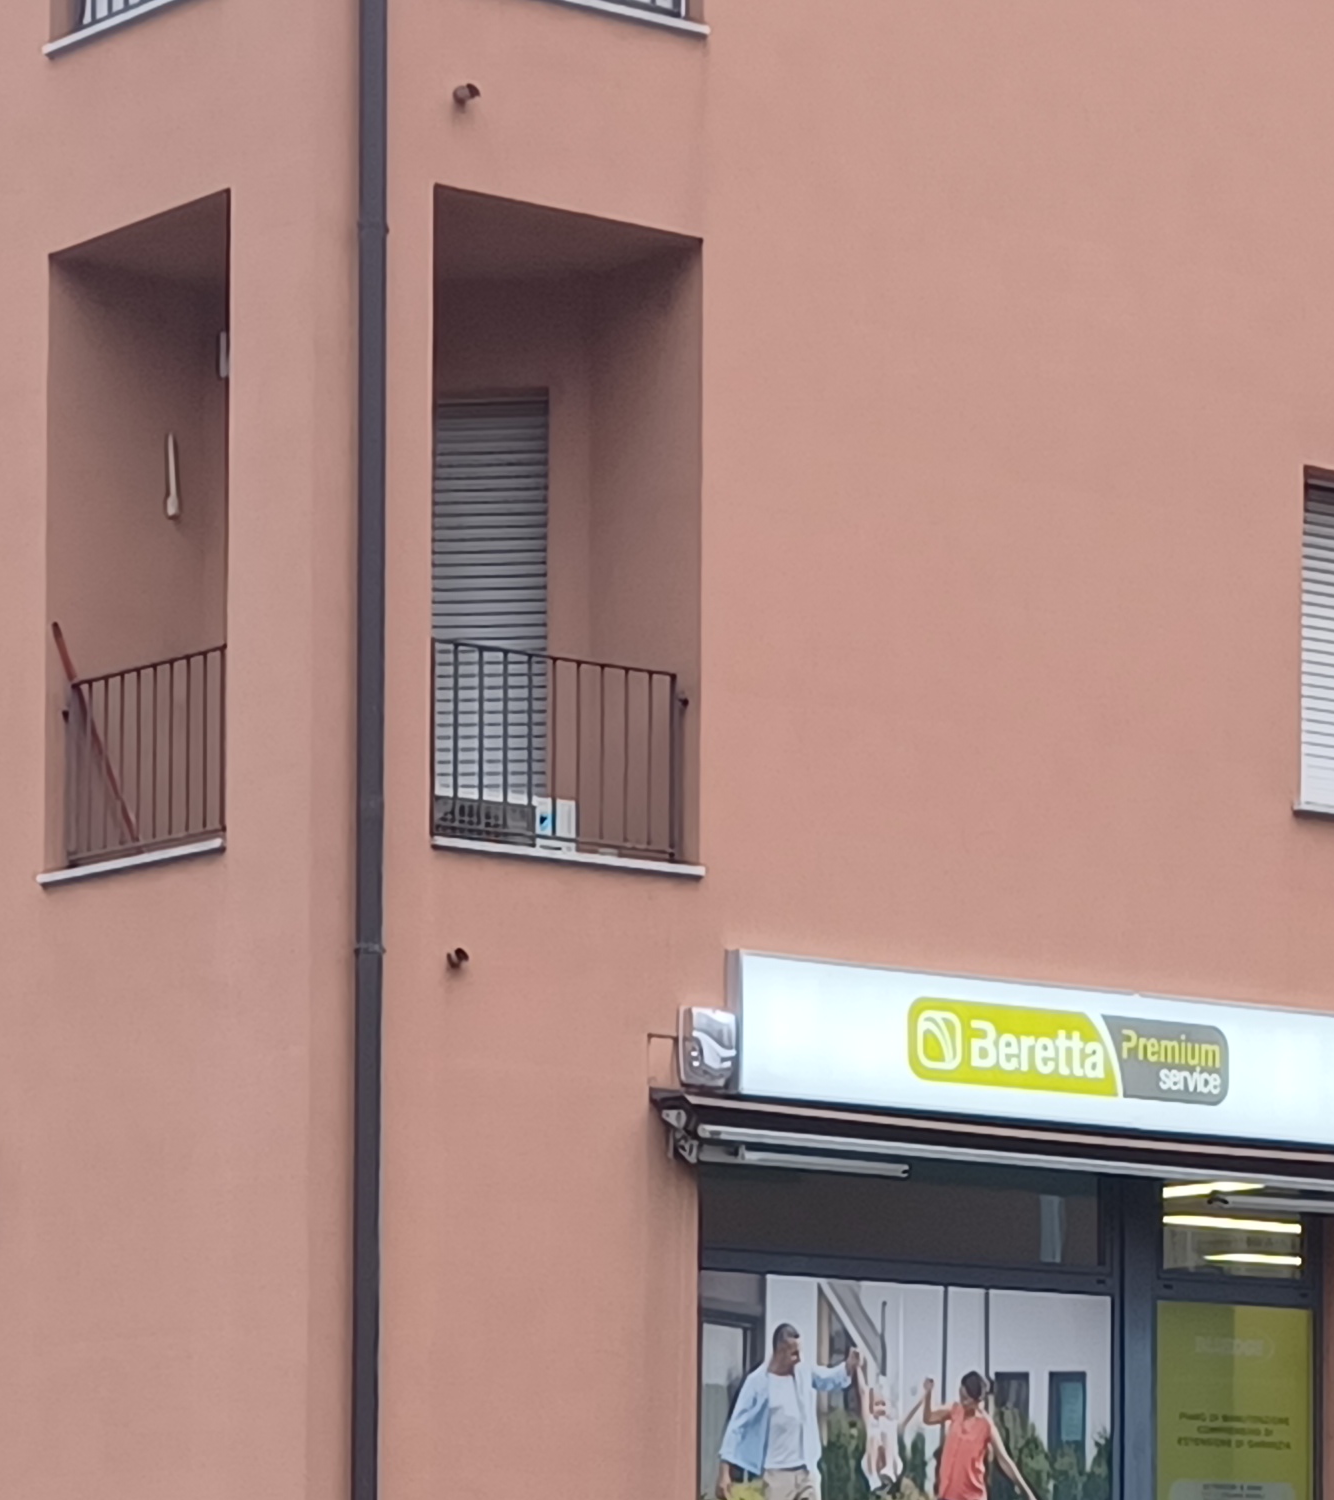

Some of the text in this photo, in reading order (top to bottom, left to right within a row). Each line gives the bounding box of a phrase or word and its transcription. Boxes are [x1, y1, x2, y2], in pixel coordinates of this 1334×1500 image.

[969, 1019, 1221, 1079] Beretta Premium
[1159, 1066, 1221, 1094] service
